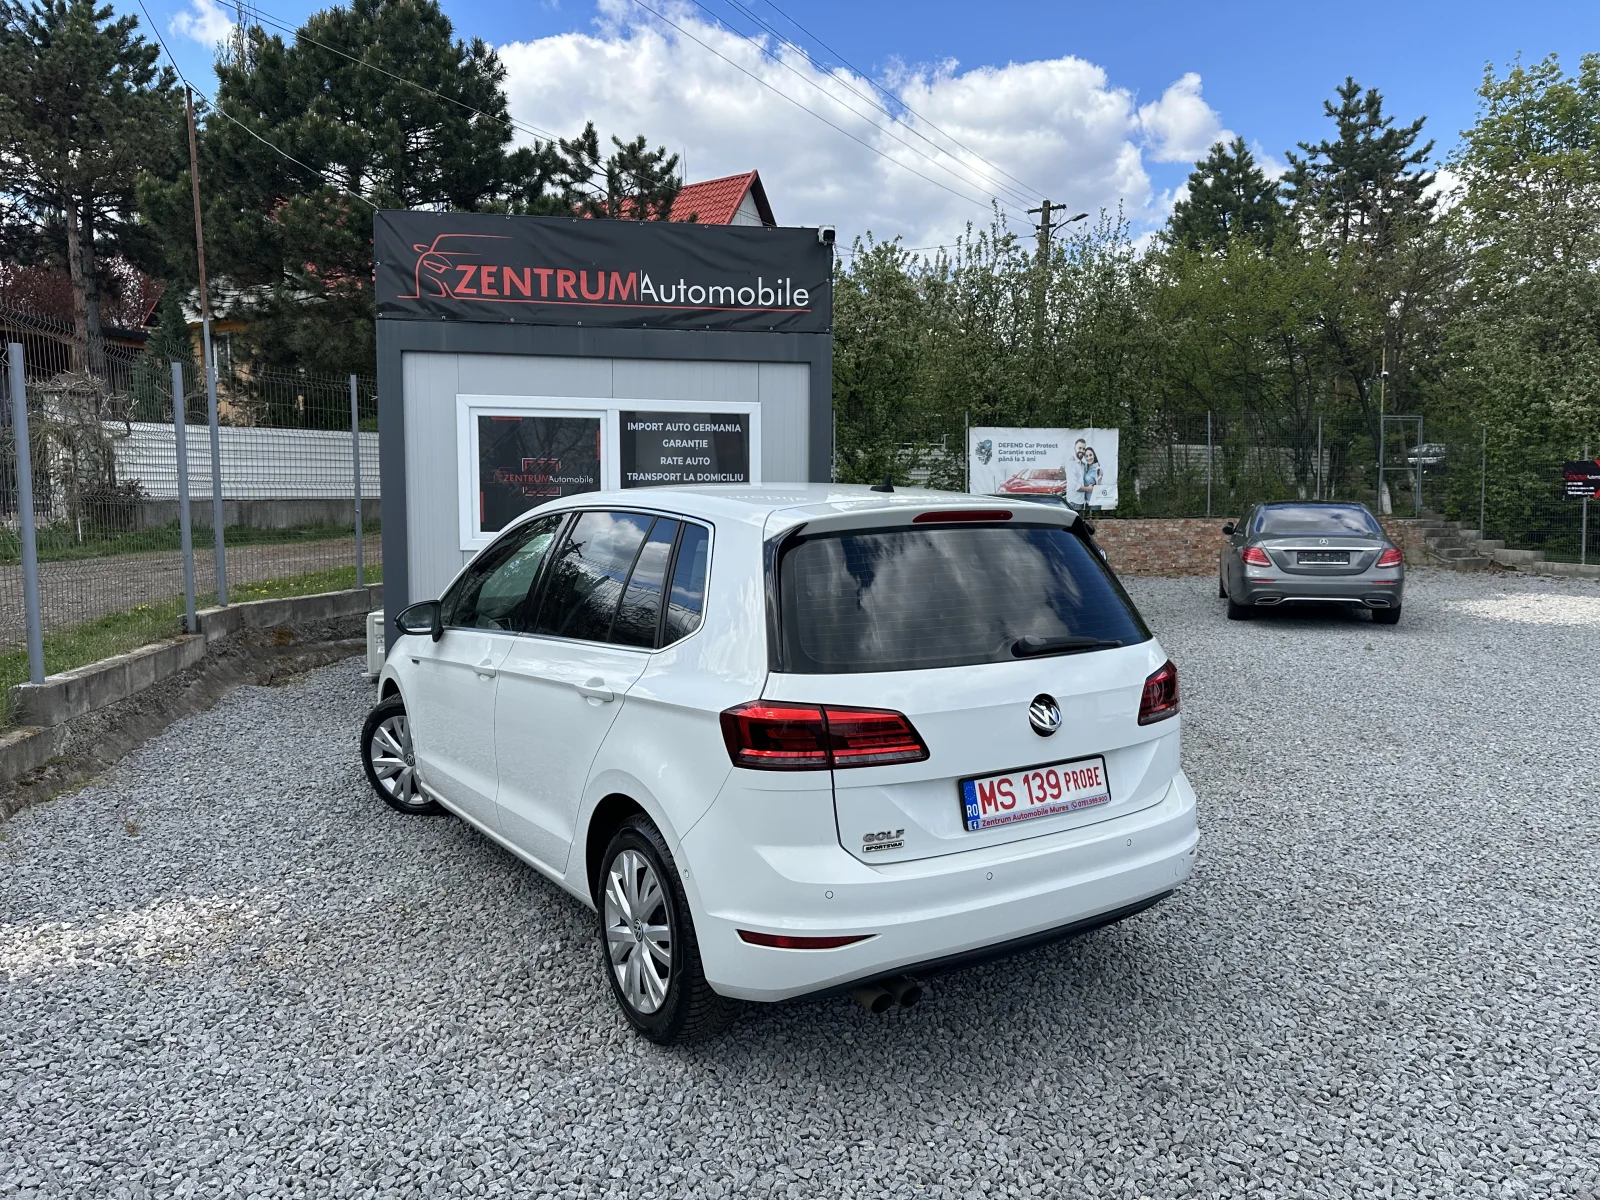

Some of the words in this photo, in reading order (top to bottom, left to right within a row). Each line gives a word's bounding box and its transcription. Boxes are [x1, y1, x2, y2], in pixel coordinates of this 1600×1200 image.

[454, 264, 637, 301] ZENTRUM
[640, 271, 810, 307] Automobile
[627, 422, 663, 431] IMPORT
[665, 423, 691, 431] AUTO
[693, 423, 742, 432] GERMANIA
[662, 439, 708, 450] GARANȚIE
[660, 457, 683, 465] RATE
[685, 457, 711, 465] AUTO
[503, 474, 549, 483] ZENTRUM
[549, 475, 594, 484] Automobile
[627, 472, 681, 481] TRANSPORT
[683, 473, 695, 481] LA
[697, 473, 744, 482] DOMICILIU
[978, 777, 1017, 815] MS
[1022, 769, 1062, 805] 139
[1063, 766, 1102, 792] PROBE
[966, 804, 979, 818] RO
[982, 815, 1012, 827] Zentrum
[1012, 807, 1049, 821] Automobile
[863, 828, 905, 842] GOLF
[865, 842, 902, 851] SPORTSVAN
